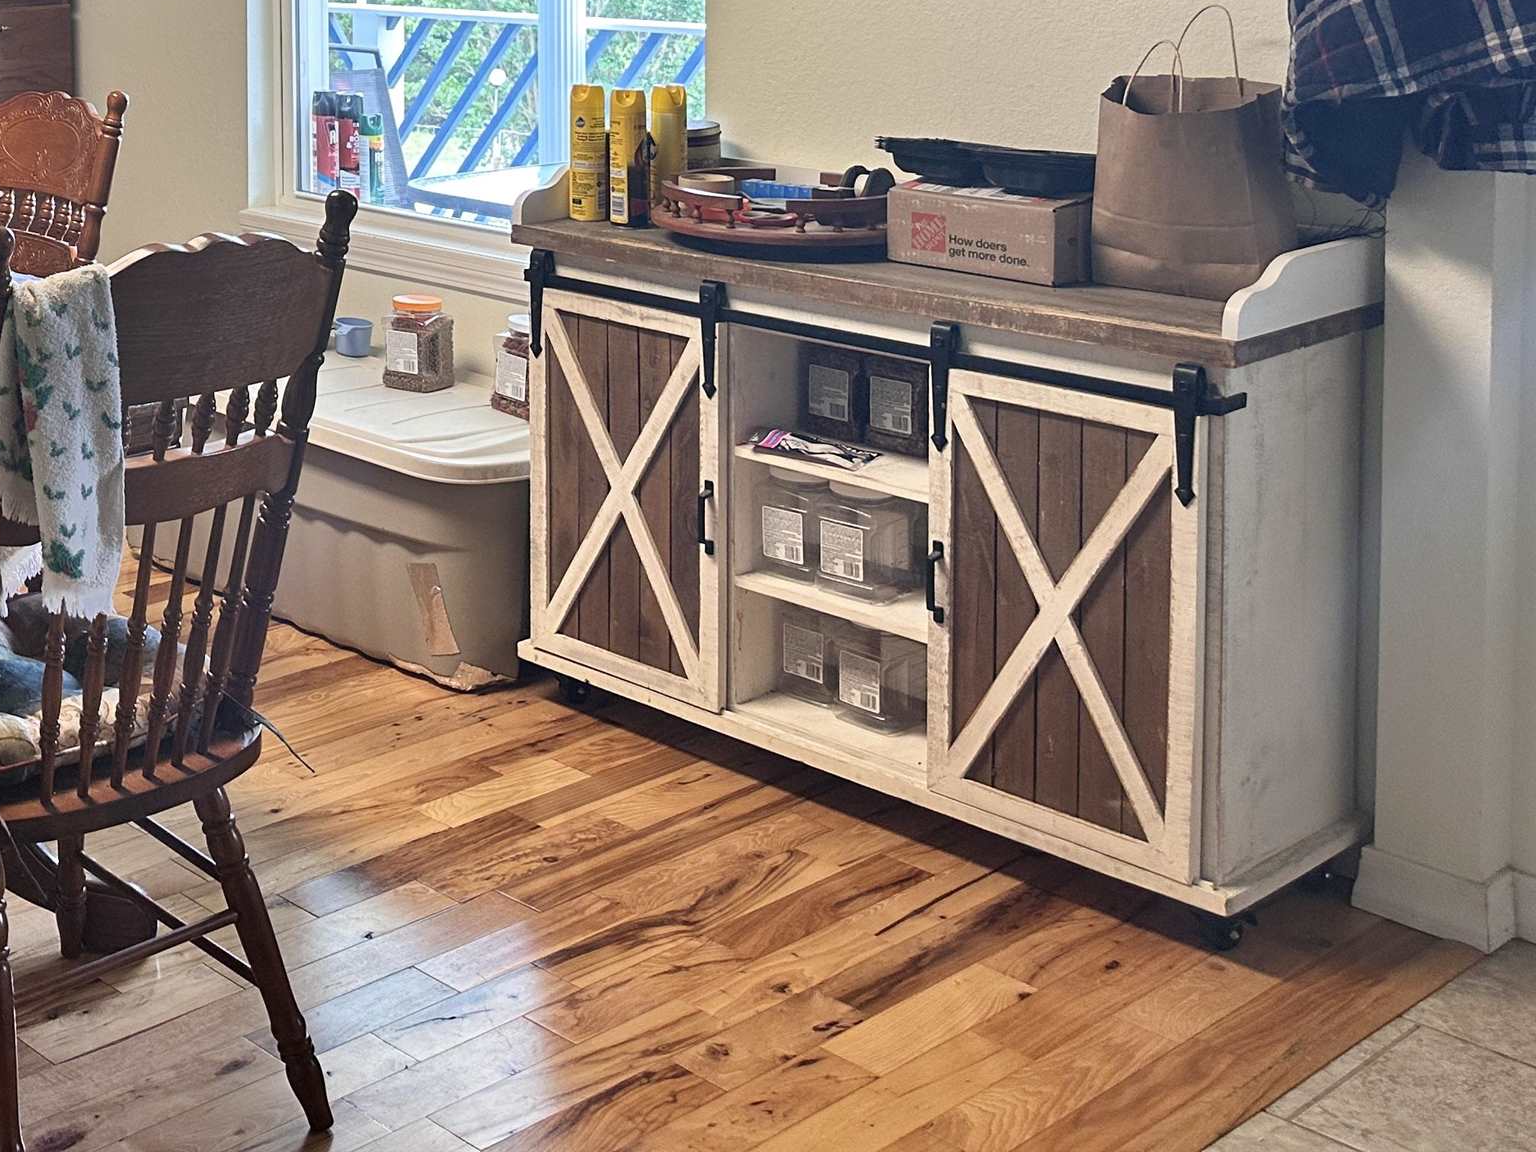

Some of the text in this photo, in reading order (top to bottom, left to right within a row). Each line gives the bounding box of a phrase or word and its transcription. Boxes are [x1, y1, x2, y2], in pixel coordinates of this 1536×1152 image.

[949, 234, 1007, 252] How doers
[948, 247, 1030, 267] get more done.
